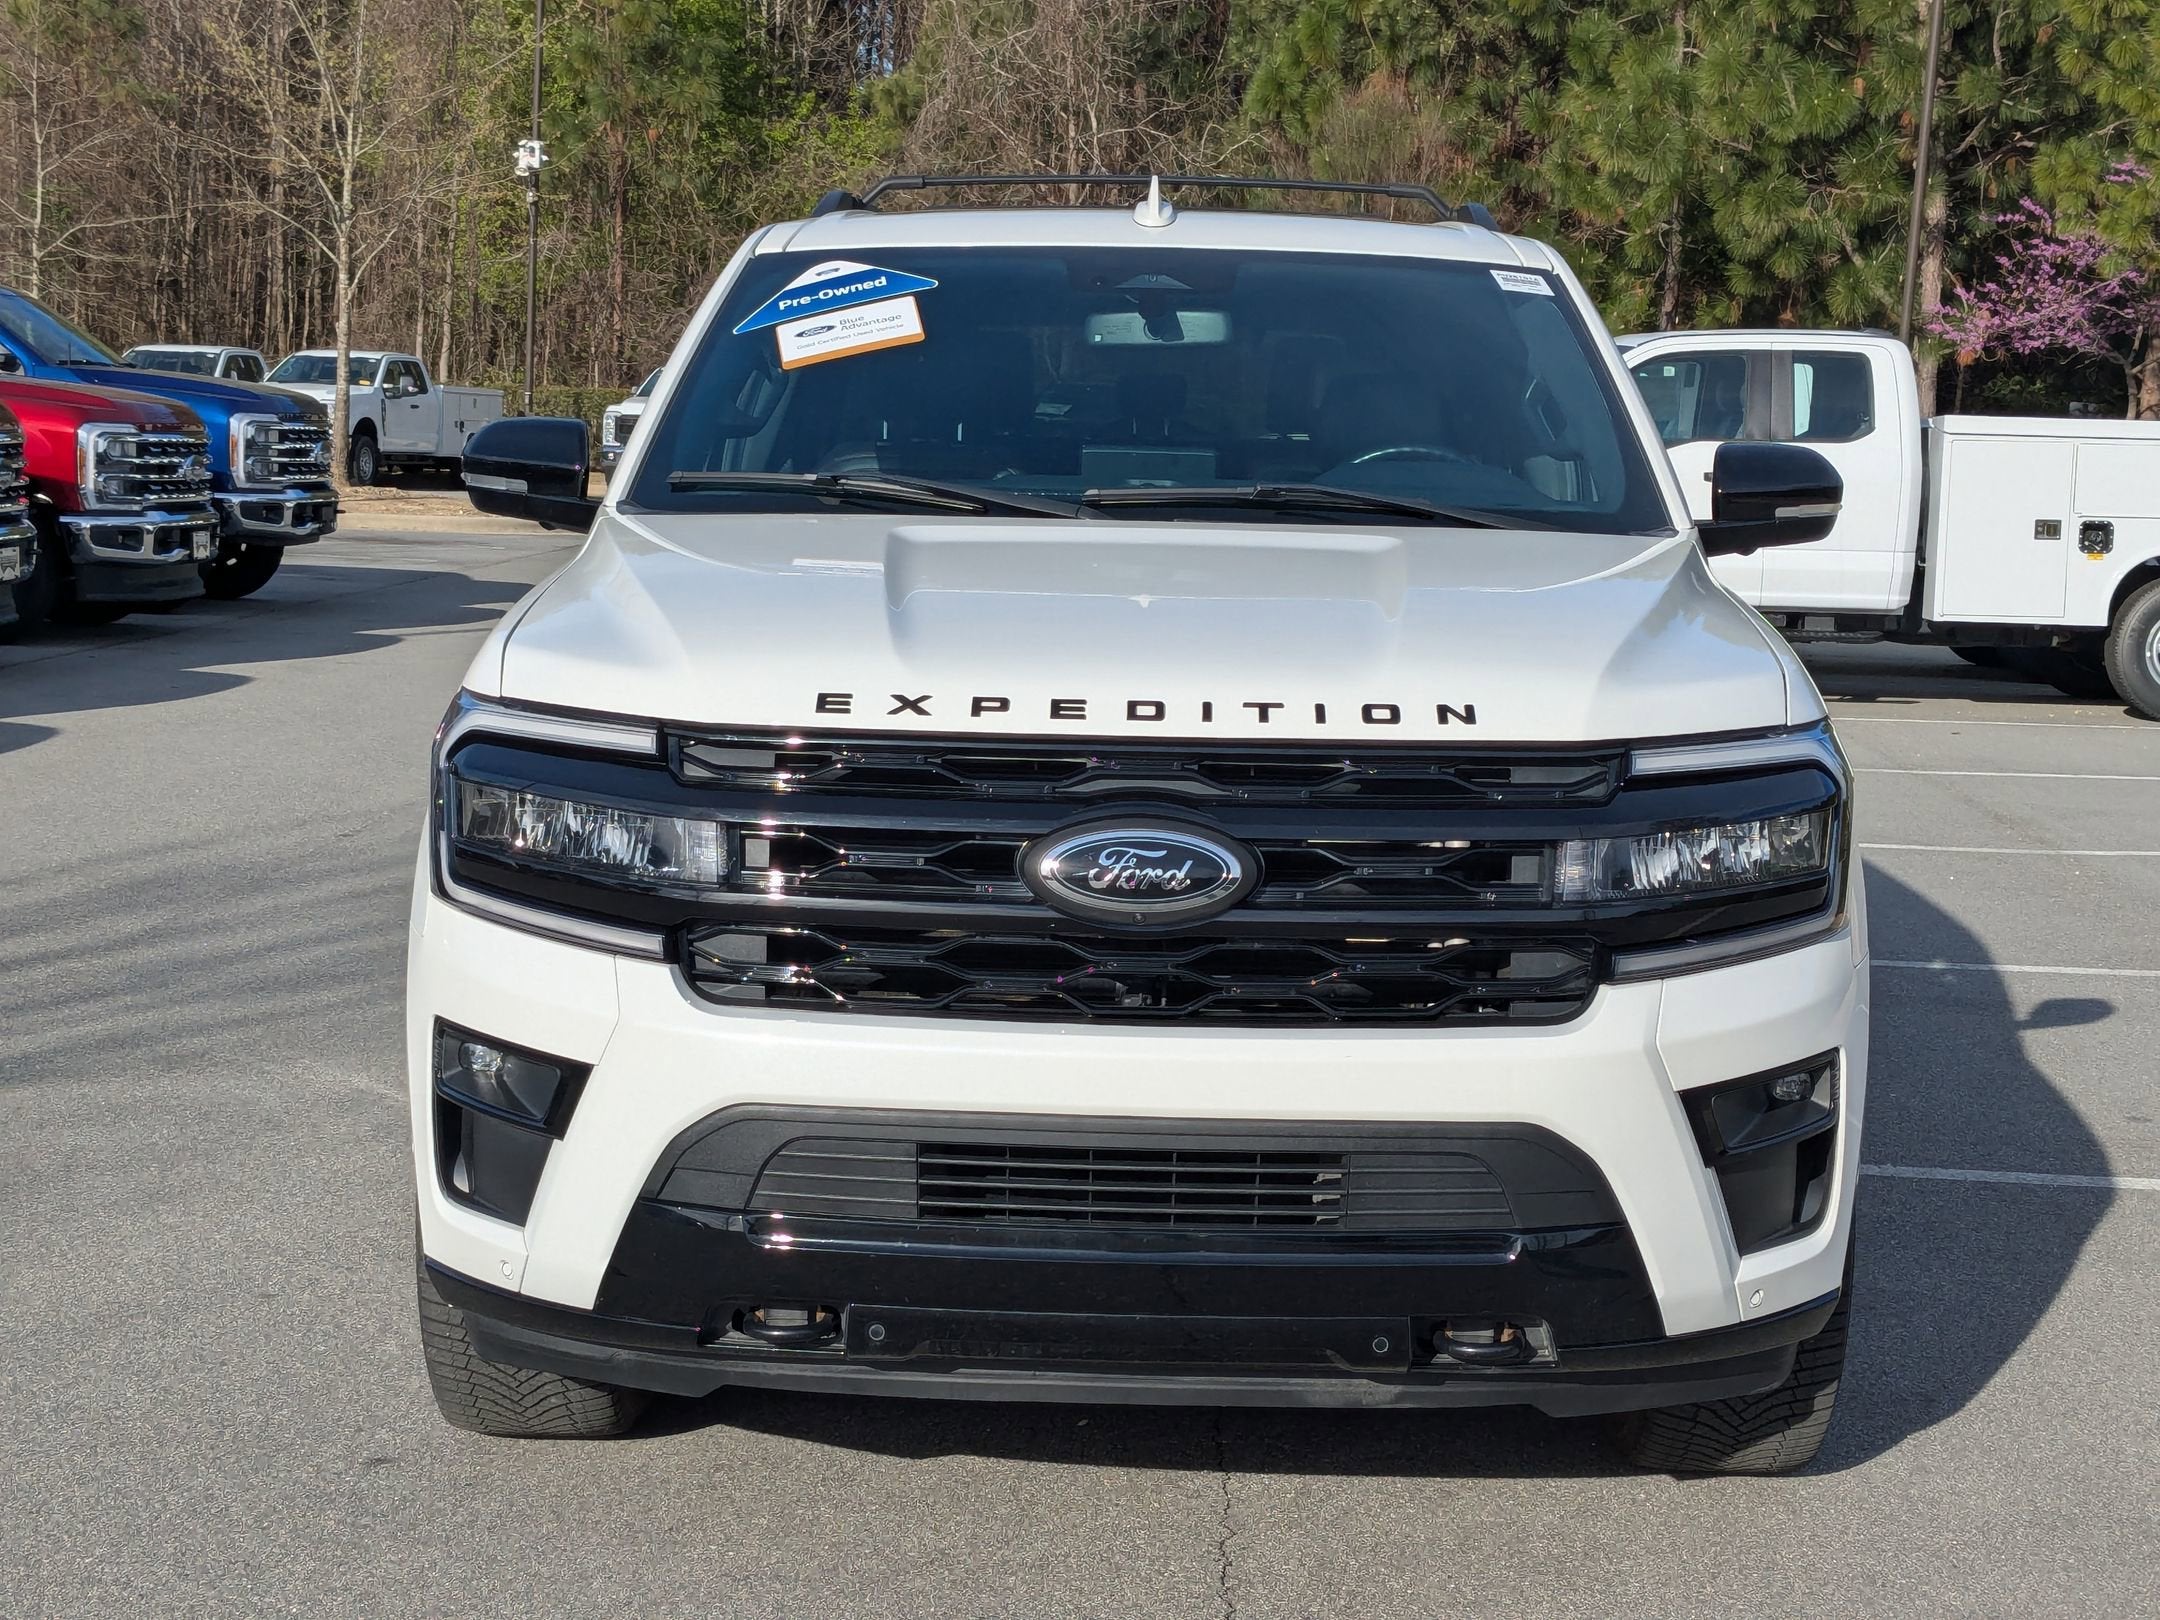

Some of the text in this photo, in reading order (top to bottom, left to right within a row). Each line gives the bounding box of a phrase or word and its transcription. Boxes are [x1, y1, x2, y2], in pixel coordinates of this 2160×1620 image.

[778, 276, 888, 311] Pre-Owned
[839, 316, 865, 325] Blue
[840, 314, 902, 331] Advantage
[817, 334, 852, 345] Certified
[853, 329, 874, 337] Used
[814, 692, 1477, 726] EXPEDITION
[1087, 846, 1194, 891] Ford
